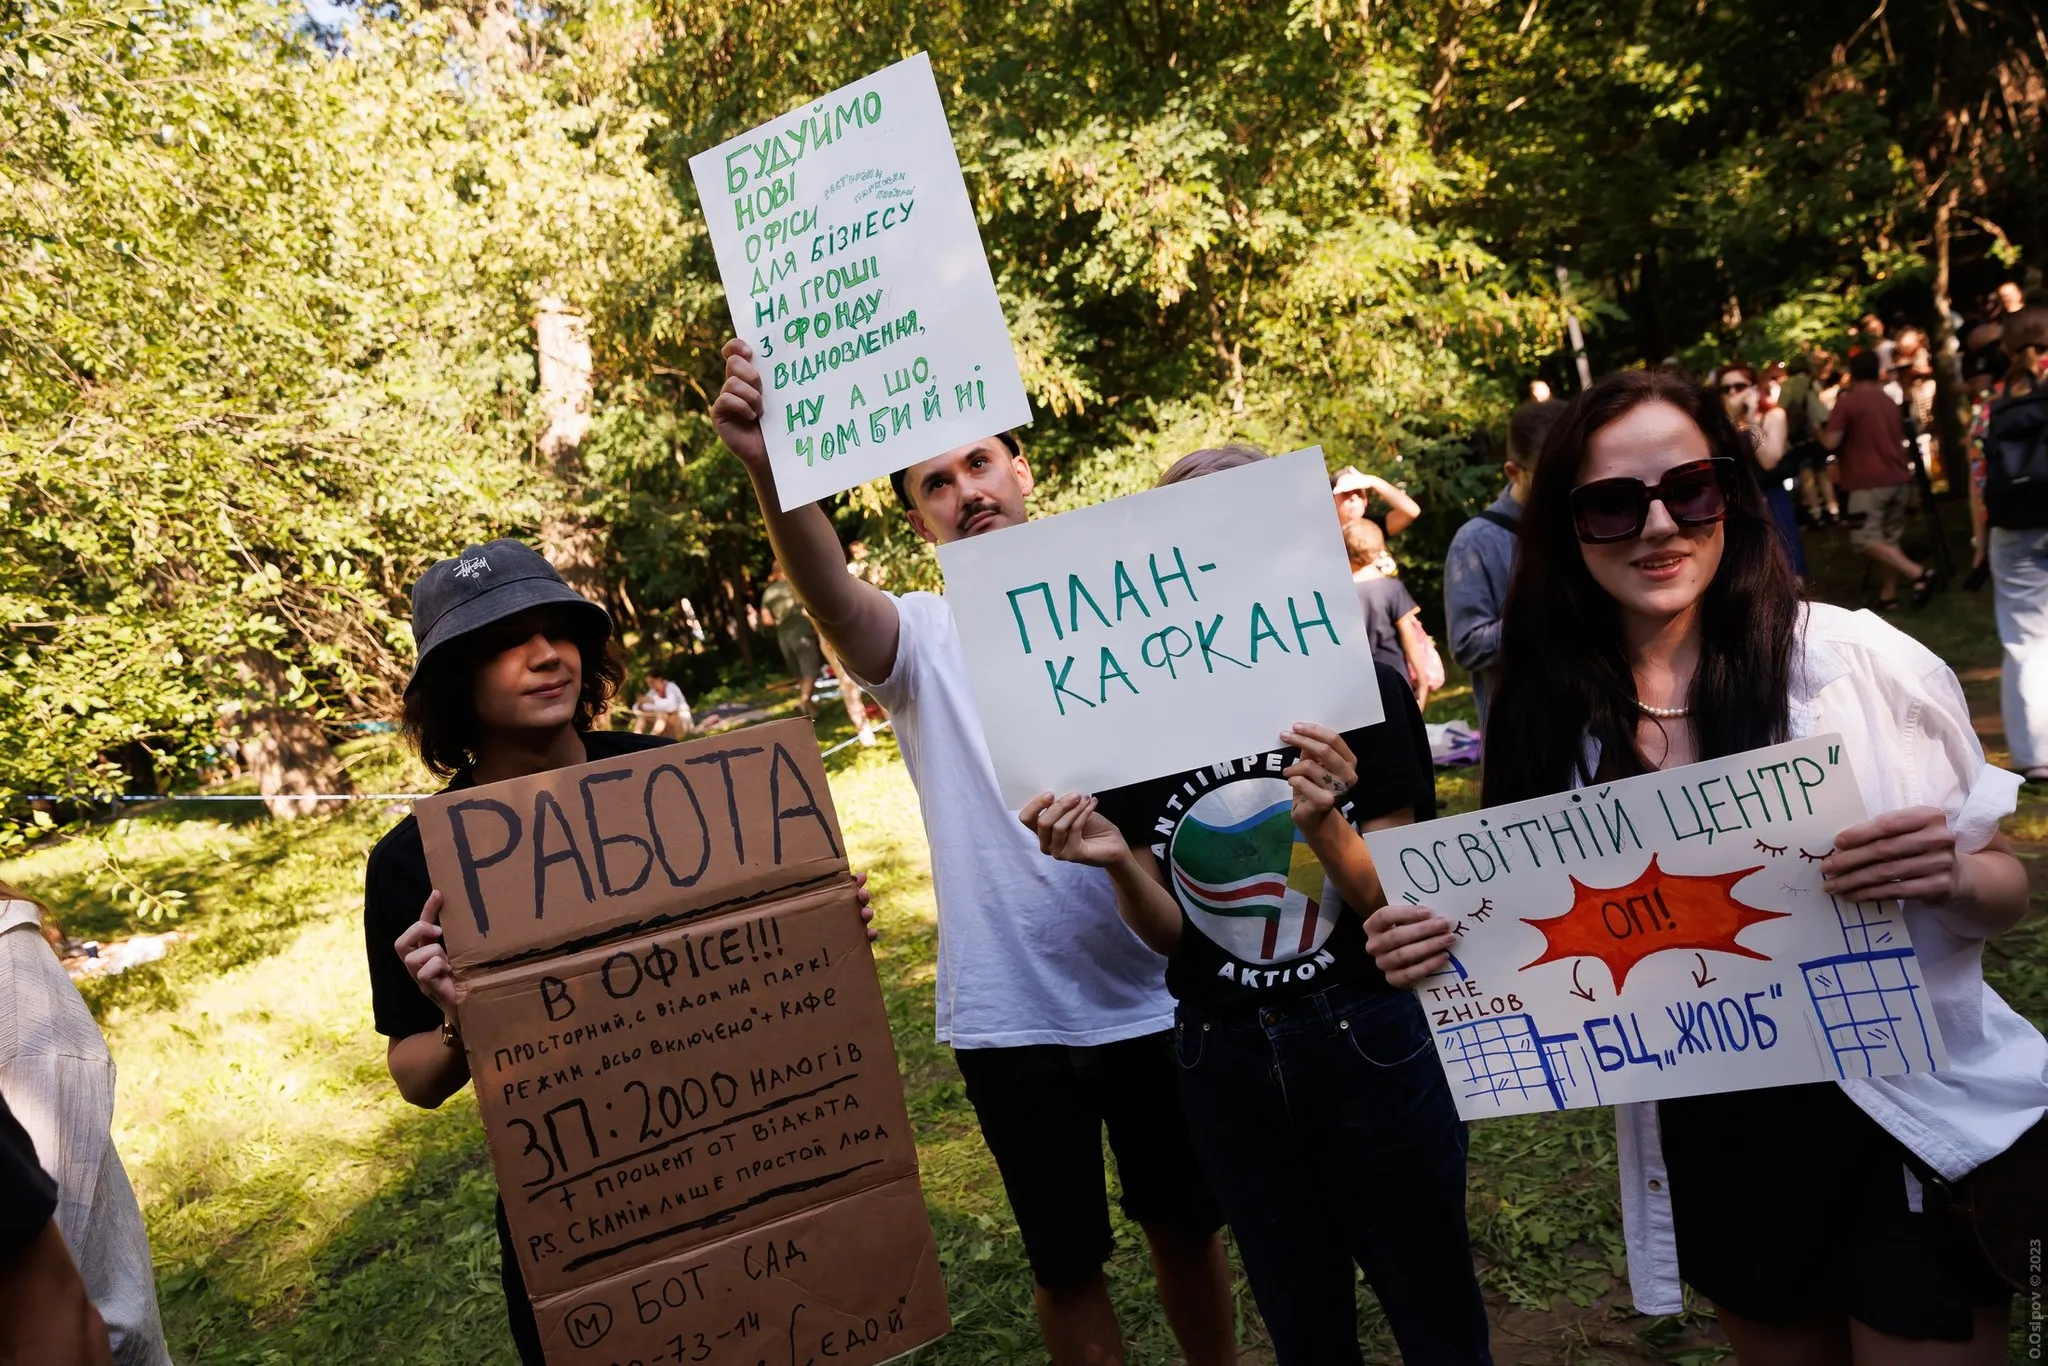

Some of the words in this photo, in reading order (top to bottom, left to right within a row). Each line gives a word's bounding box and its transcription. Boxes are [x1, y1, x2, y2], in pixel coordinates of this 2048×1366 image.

[725, 90, 882, 195] БУДУЙМО
[734, 171, 796, 231] НОВІ
[745, 205, 818, 264] ОФІСИ
[749, 251, 798, 298] ДЛЯ
[810, 199, 914, 264] БІЗНЕСУ
[755, 293, 790, 328] НА
[800, 255, 881, 309] ГРОШІ
[783, 289, 883, 349] ФОНДУ
[774, 309, 926, 390] ВІДНОВЛЕННЯ,
[785, 394, 825, 434] НУ
[850, 384, 867, 410] А
[954, 364, 986, 413] НІ
[1006, 546, 1217, 655] ПЛАН-
[1045, 590, 1341, 716] КАФКАН
[447, 742, 841, 938] РАБОТА
[1601, 886, 1678, 939] ОП!
[539, 975, 576, 1022] В
[601, 917, 784, 1000] ОФІСЕ!!!
[728, 978, 751, 997] НА
[763, 947, 831, 987] ПАРК!
[1217, 948, 1336, 989] AKTION
[1427, 981, 1483, 1003] THE
[1432, 993, 1525, 1027] ZHLOB
[503, 1063, 584, 1107] РЕЖИМ
[623, 1070, 740, 1144] 2000
[749, 1043, 863, 1097] НАЛОГІВ
[707, 1133, 737, 1157] ОТ
[751, 1092, 860, 1143] ВІДКАТА
[659, 1175, 725, 1215] ЛИШЕ
[839, 1123, 889, 1151] ЛЮД
[743, 1239, 807, 1281] САД
[609, 1310, 761, 1366] -73-14
